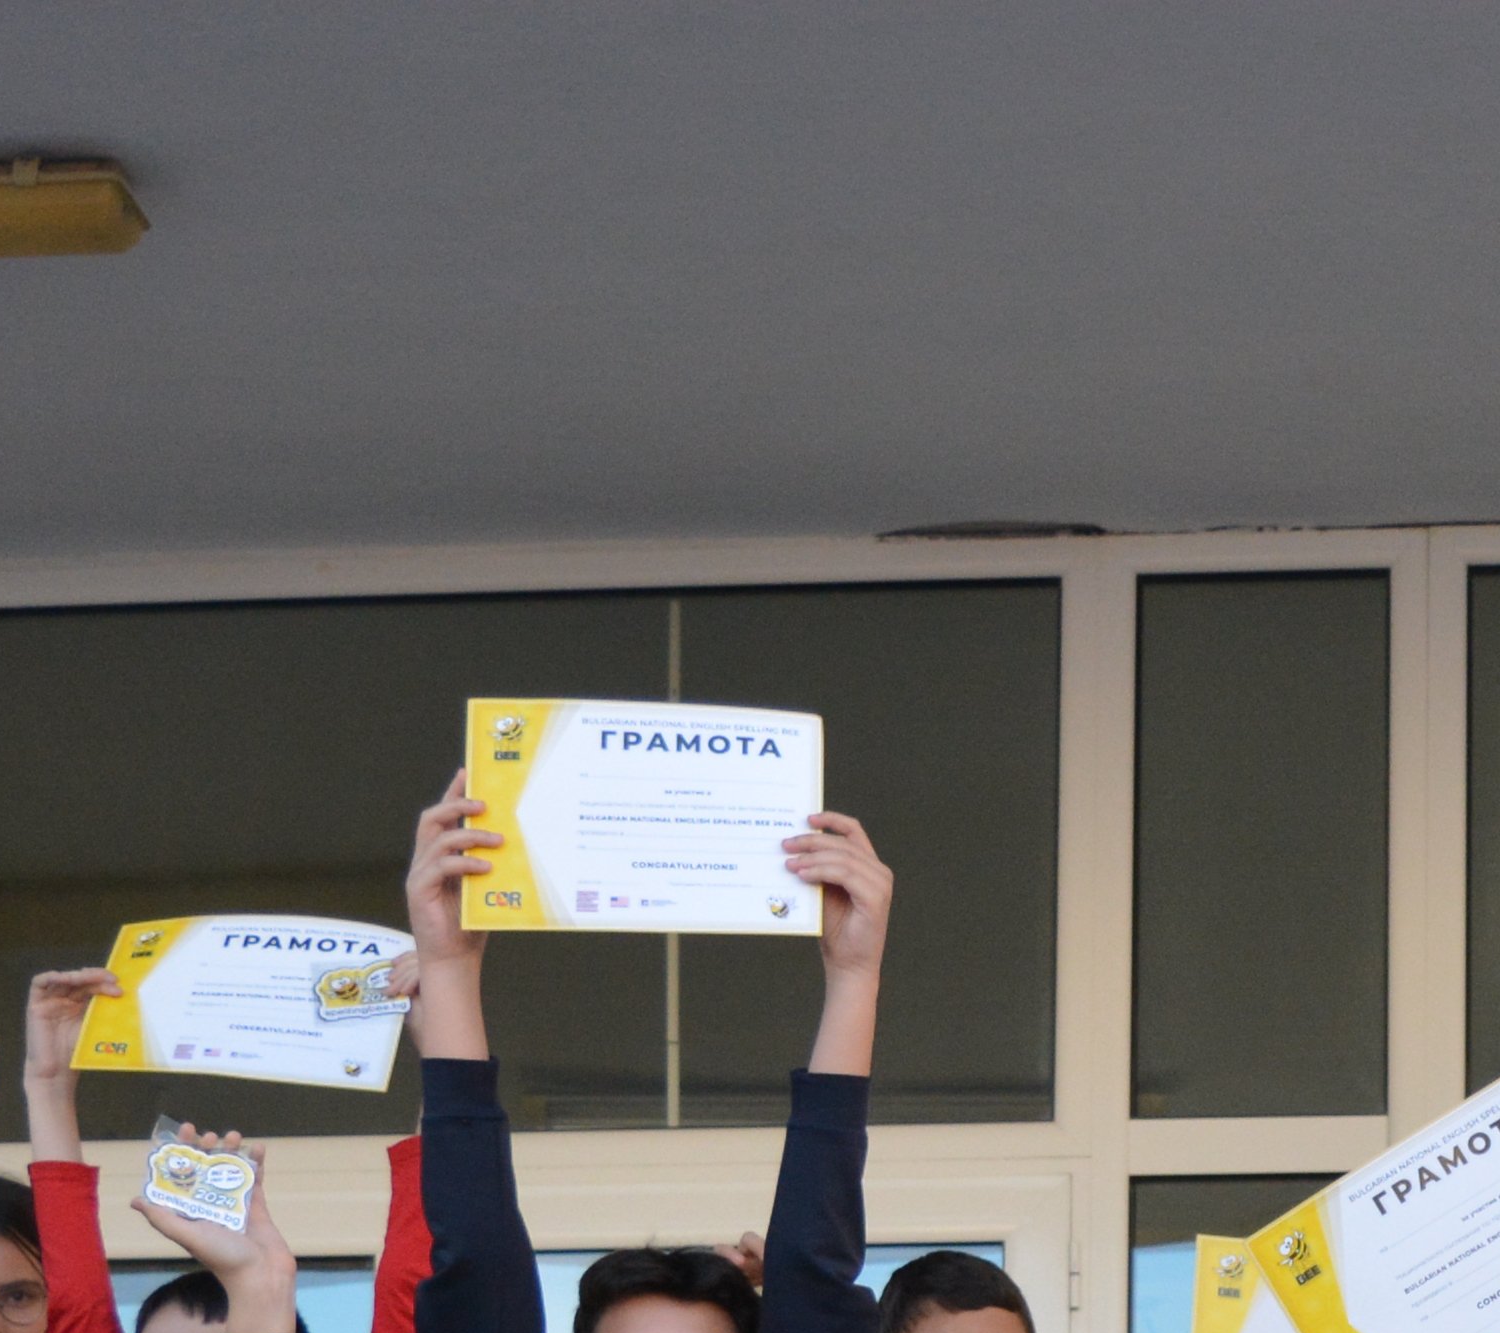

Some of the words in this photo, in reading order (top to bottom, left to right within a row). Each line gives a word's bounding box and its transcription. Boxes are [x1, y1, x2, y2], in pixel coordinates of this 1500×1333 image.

[601, 731, 781, 758] ГРАМОТА
[631, 861, 738, 870] CONGRATULATIONS!
[224, 935, 380, 956] ГРАМОТА
[196, 1188, 237, 1208] 2024
[1295, 1265, 1322, 1287] BEE
